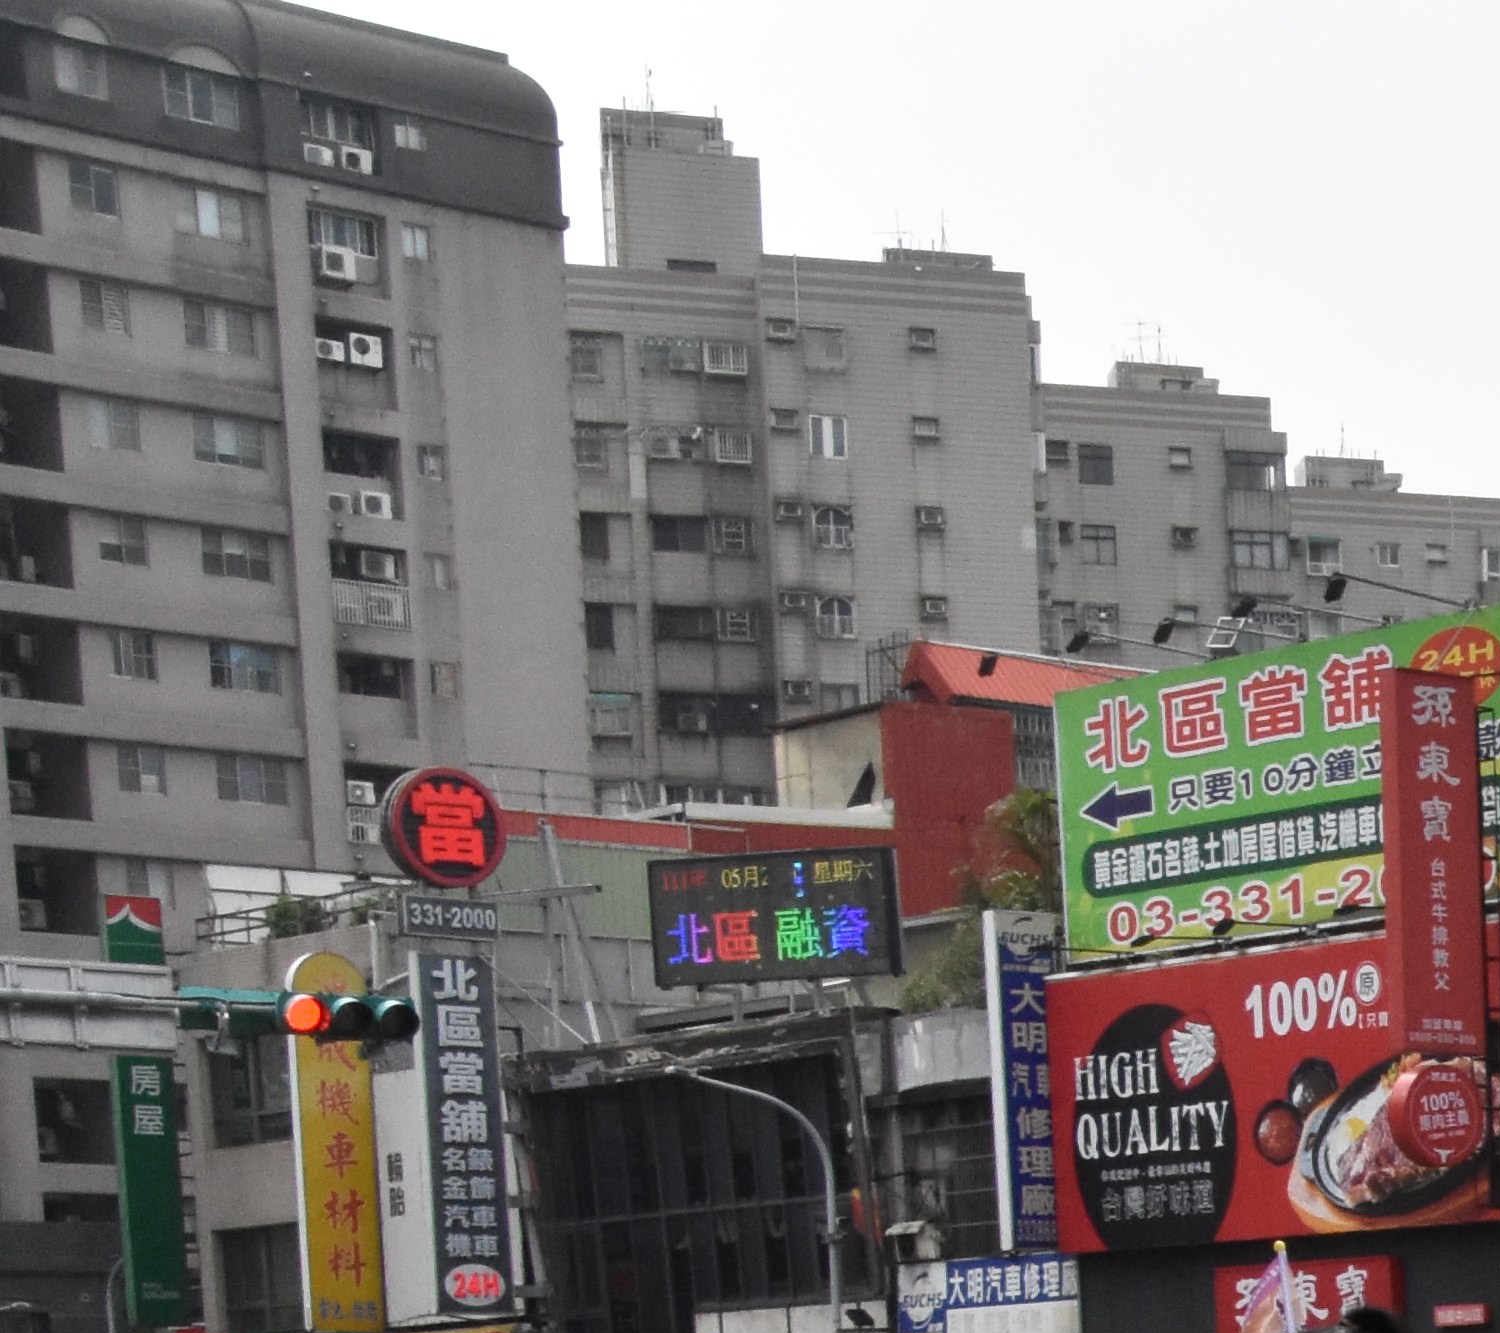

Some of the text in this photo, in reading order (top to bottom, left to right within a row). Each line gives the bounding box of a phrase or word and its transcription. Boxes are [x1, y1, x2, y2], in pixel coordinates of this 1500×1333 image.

[1419, 640, 1496, 668] 24H
[1084, 643, 1394, 772] 北區當舖
[410, 785, 486, 867] 當
[410, 902, 496, 930] 331-2000
[1245, 970, 1357, 1038] 100%
[432, 959, 489, 1144] 北區當舖
[1074, 1048, 1158, 1100] HIGH
[131, 1063, 165, 1136] 房屋
[1420, 1091, 1464, 1112] 100%
[1077, 1100, 1228, 1160] QUALITY
[453, 1271, 500, 1299] 24H
[949, 1260, 1077, 1305] 大明汽車修理廠
